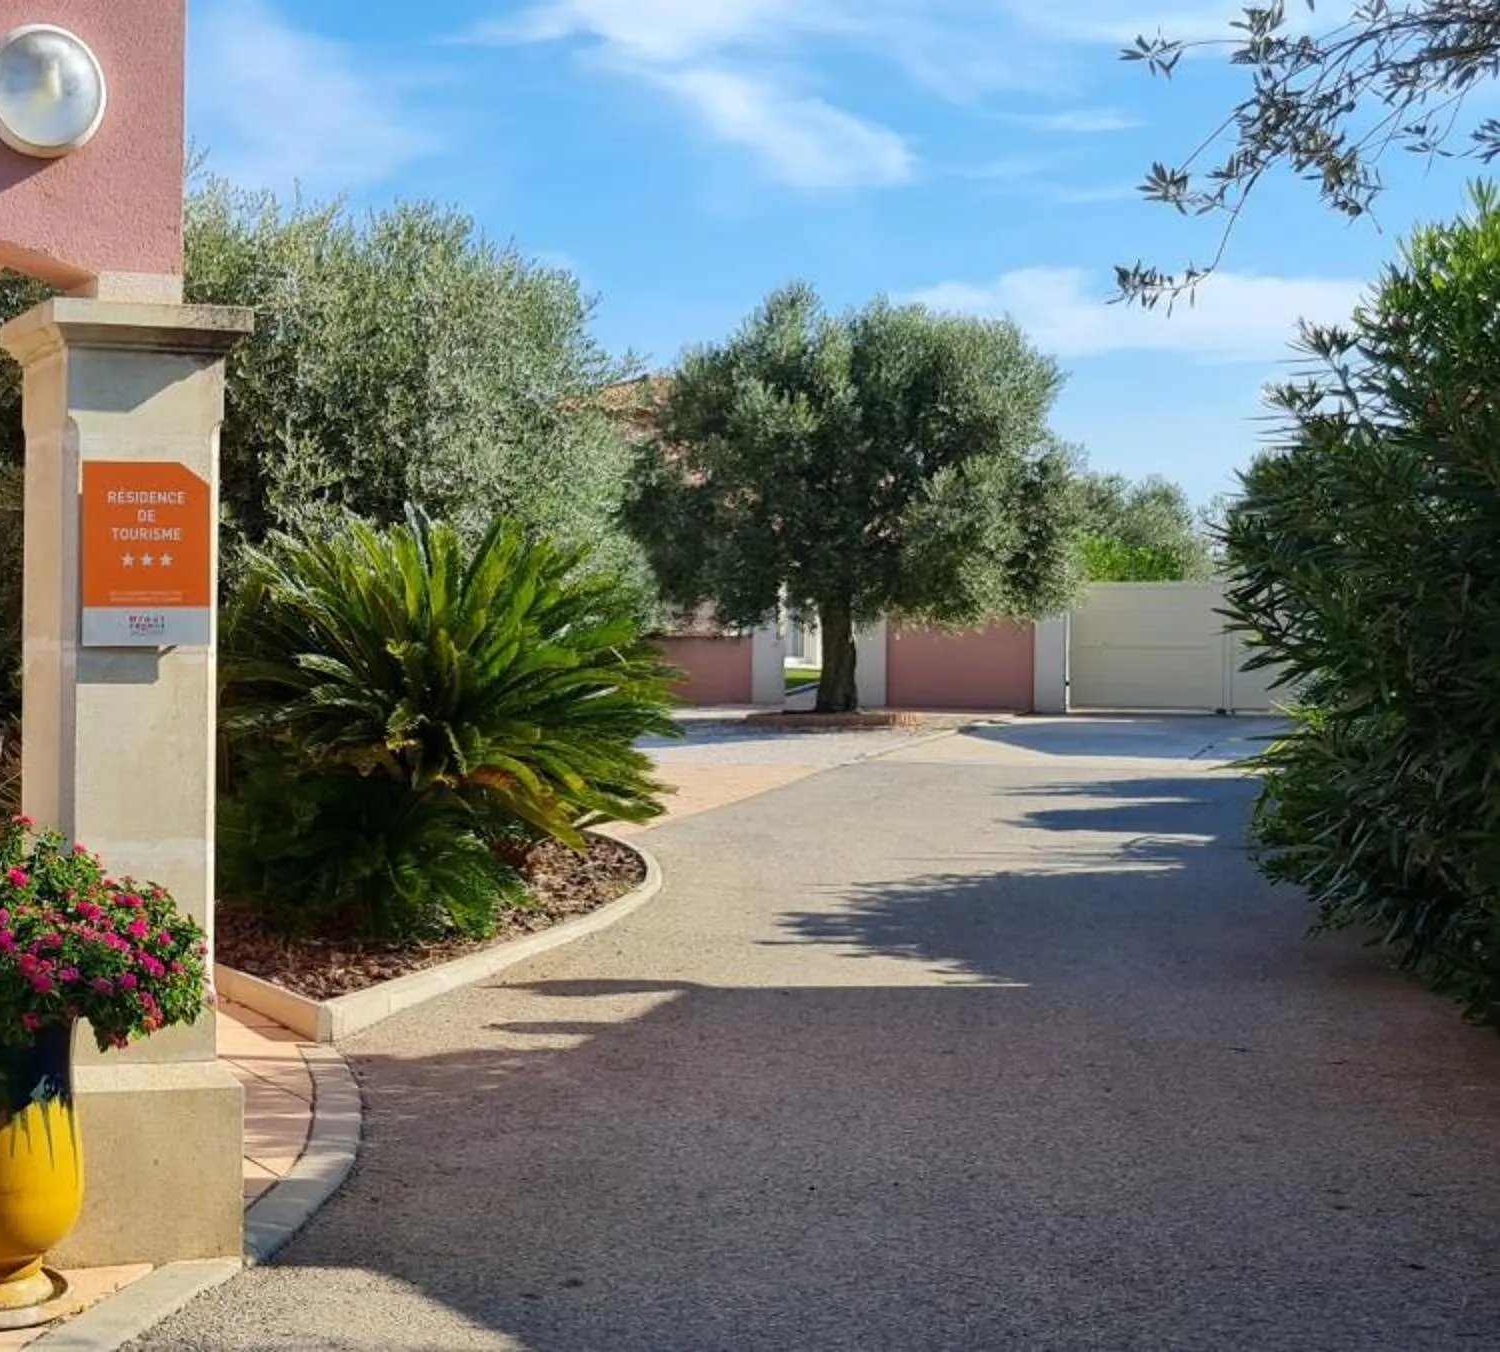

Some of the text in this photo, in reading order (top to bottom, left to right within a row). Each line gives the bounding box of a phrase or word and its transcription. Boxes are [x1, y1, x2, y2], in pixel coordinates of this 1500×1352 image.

[107, 488, 186, 505] RÉSIDENCE
[137, 508, 156, 523] DE
[111, 527, 182, 541] TOURISME
